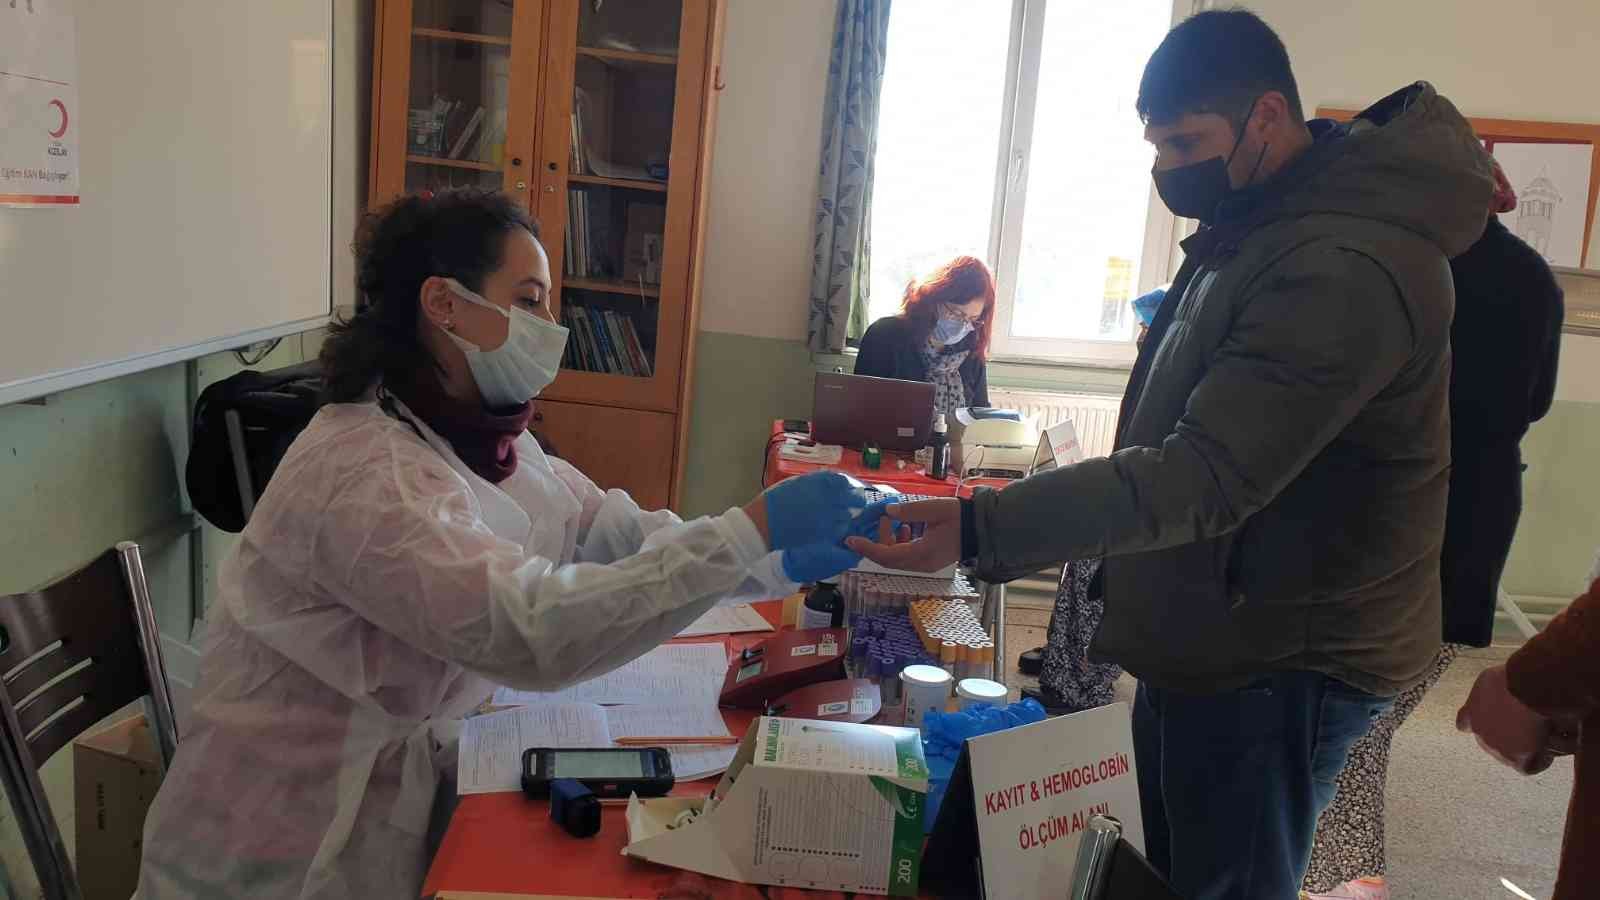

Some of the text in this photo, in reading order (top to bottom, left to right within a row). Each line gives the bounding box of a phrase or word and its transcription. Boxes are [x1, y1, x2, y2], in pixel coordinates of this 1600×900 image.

[985, 752, 1130, 816] KAYIT & HEMOGLOBİN
[1019, 815, 1069, 851] ÖLÇÜM
[897, 859, 912, 884] 200
